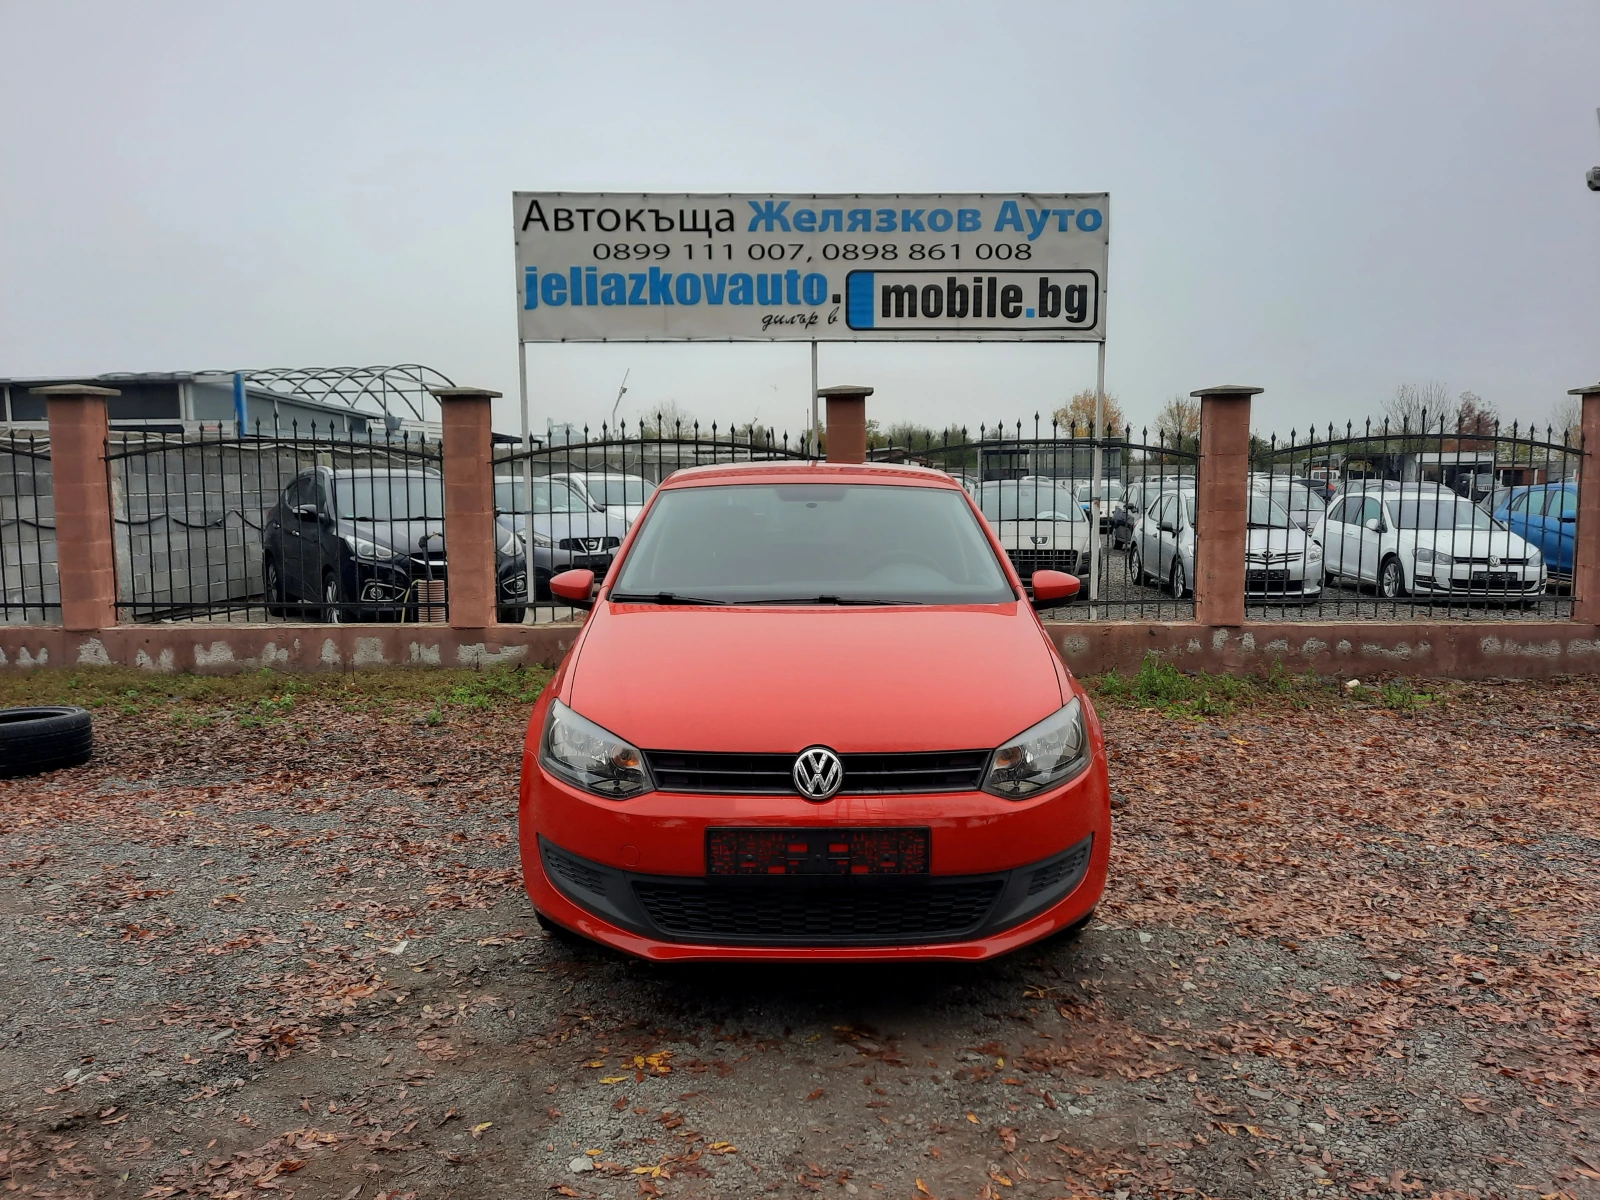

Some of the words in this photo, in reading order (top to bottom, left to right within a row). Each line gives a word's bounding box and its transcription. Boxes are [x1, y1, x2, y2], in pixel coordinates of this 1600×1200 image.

[521, 199, 735, 239] Автокъща
[747, 200, 982, 233] Желязков
[993, 200, 1104, 242] Ауто
[592, 243, 671, 261] 0899
[683, 243, 734, 261] 111
[747, 243, 813, 263] 007,
[822, 243, 899, 261] 0898
[908, 243, 961, 261] 861
[975, 243, 1033, 261] 008
[881, 276, 1088, 324] mobile.bg
[762, 311, 819, 332] дилър
